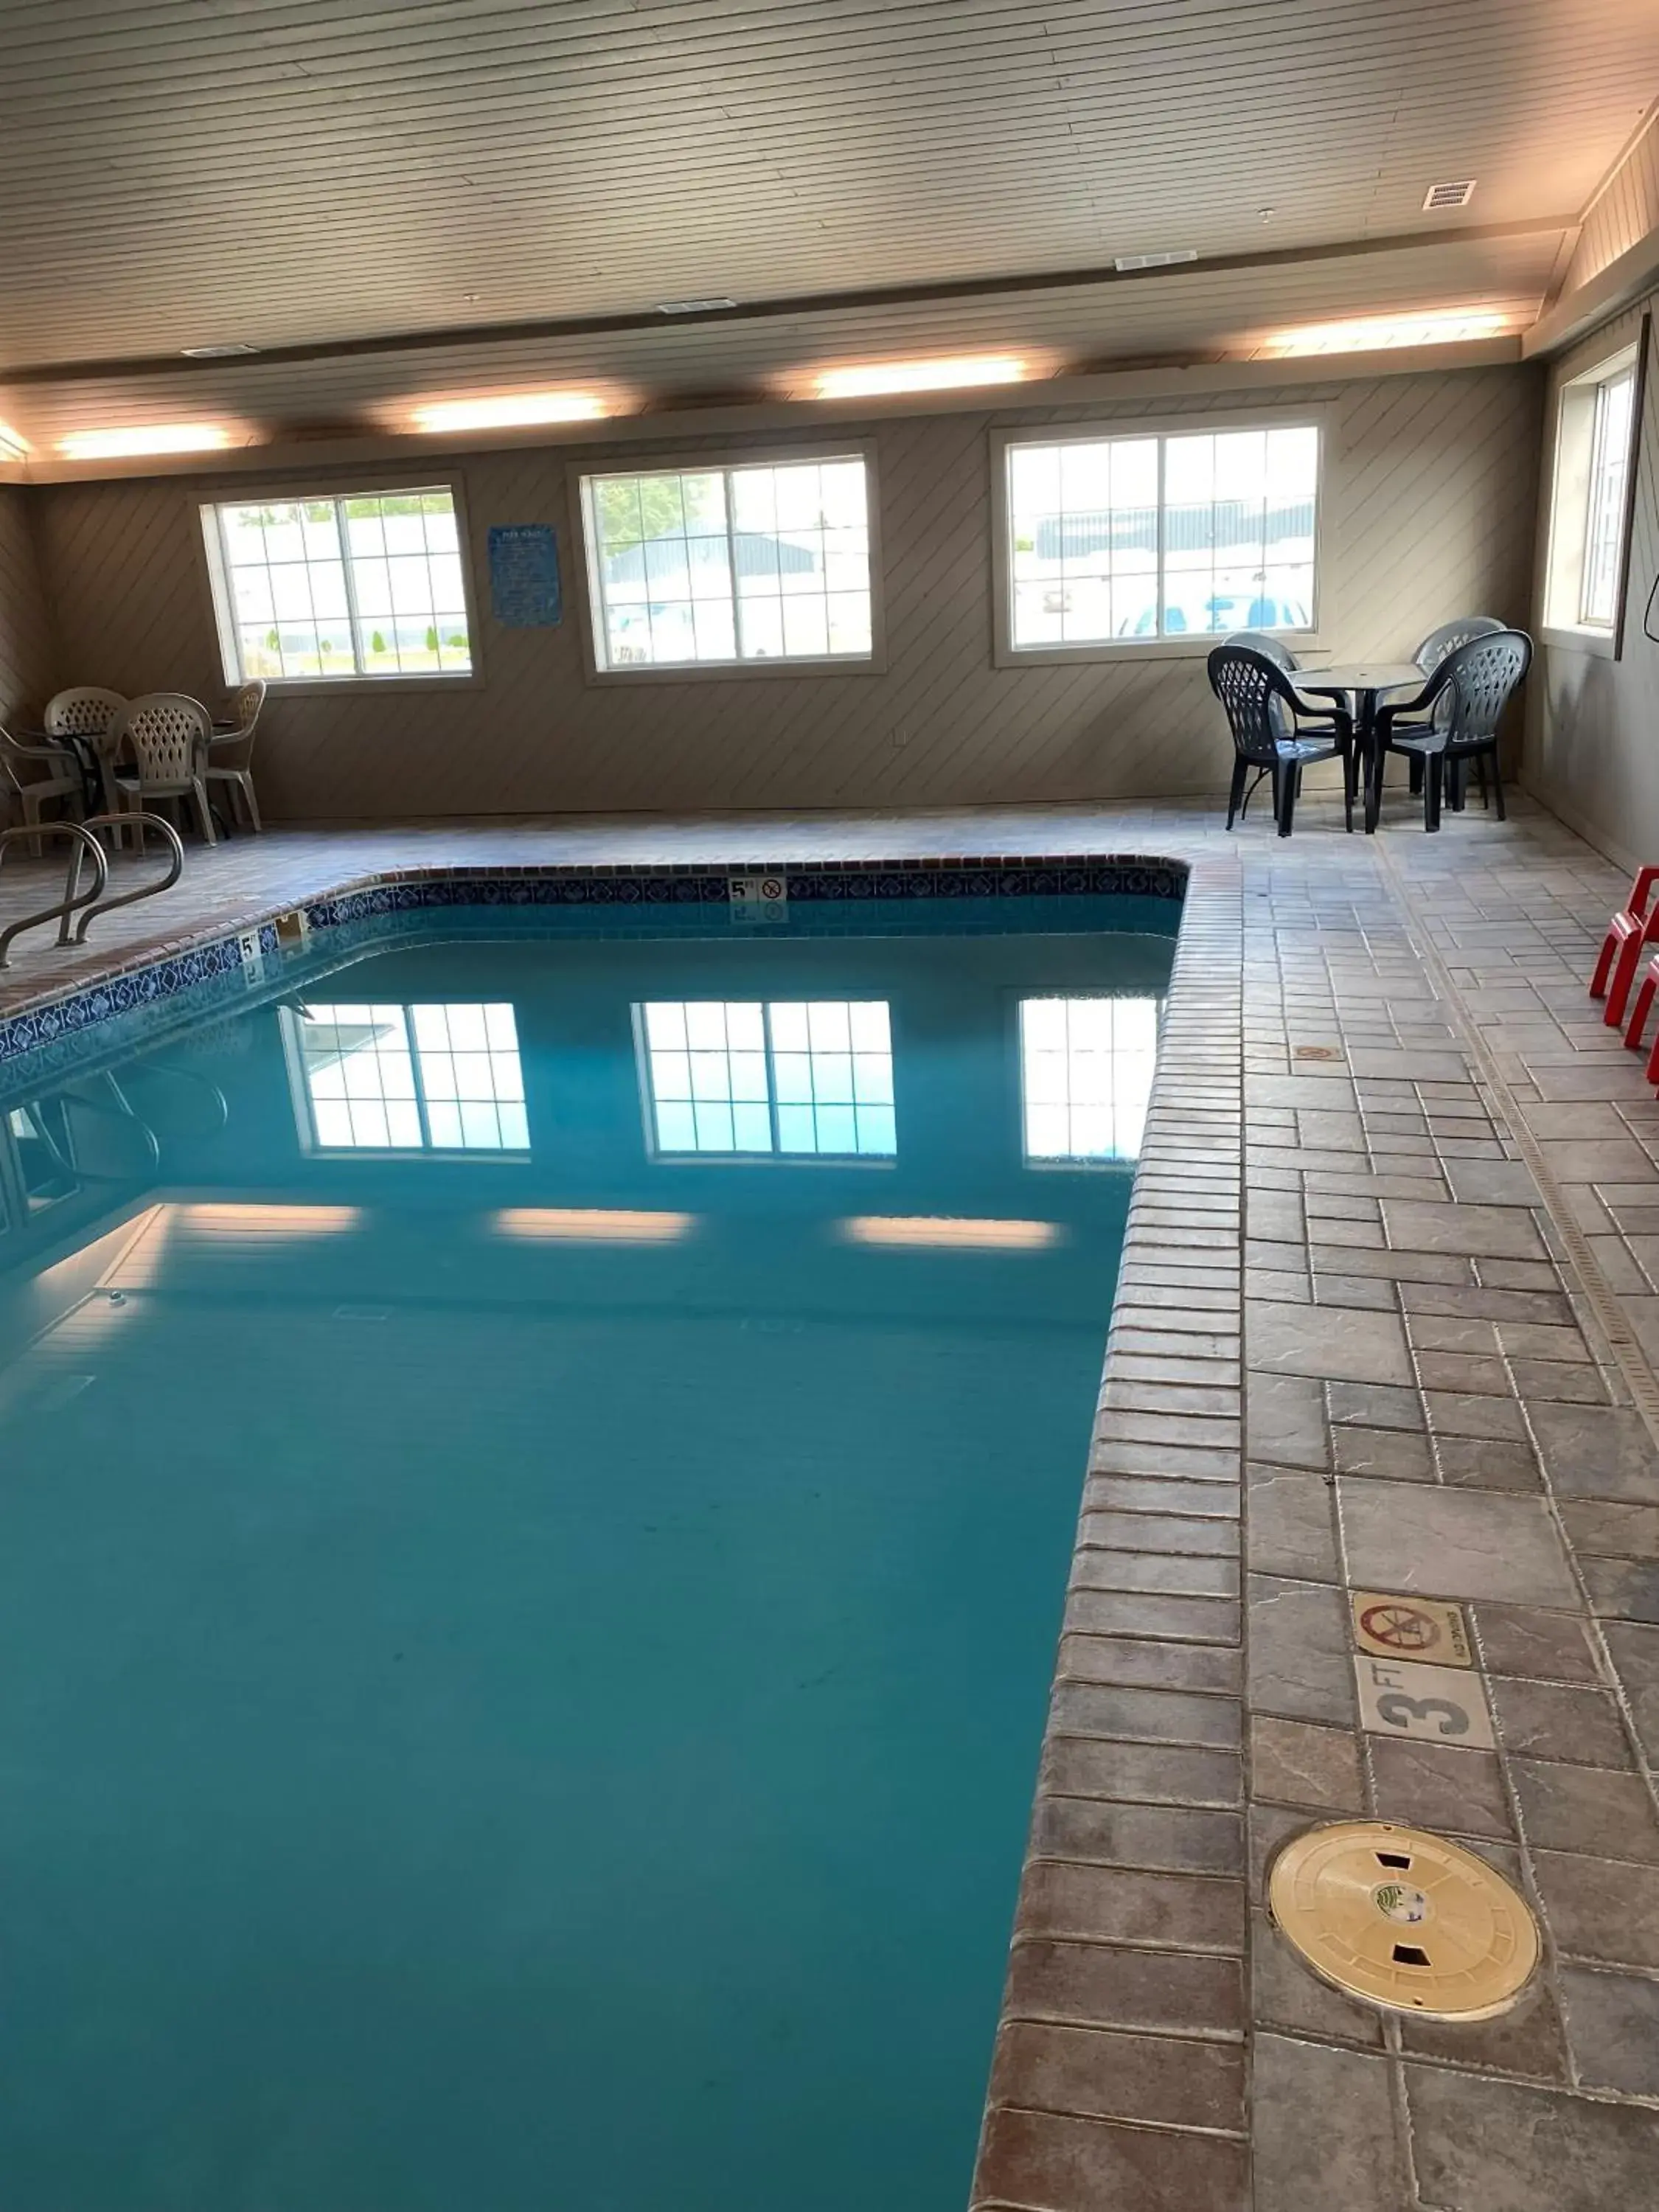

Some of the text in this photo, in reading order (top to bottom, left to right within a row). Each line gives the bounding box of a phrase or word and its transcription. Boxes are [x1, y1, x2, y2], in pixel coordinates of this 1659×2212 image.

[731, 881, 745, 897] 5
[242, 936, 252, 956] 5
[1371, 1663, 1469, 1734] 3 FT
